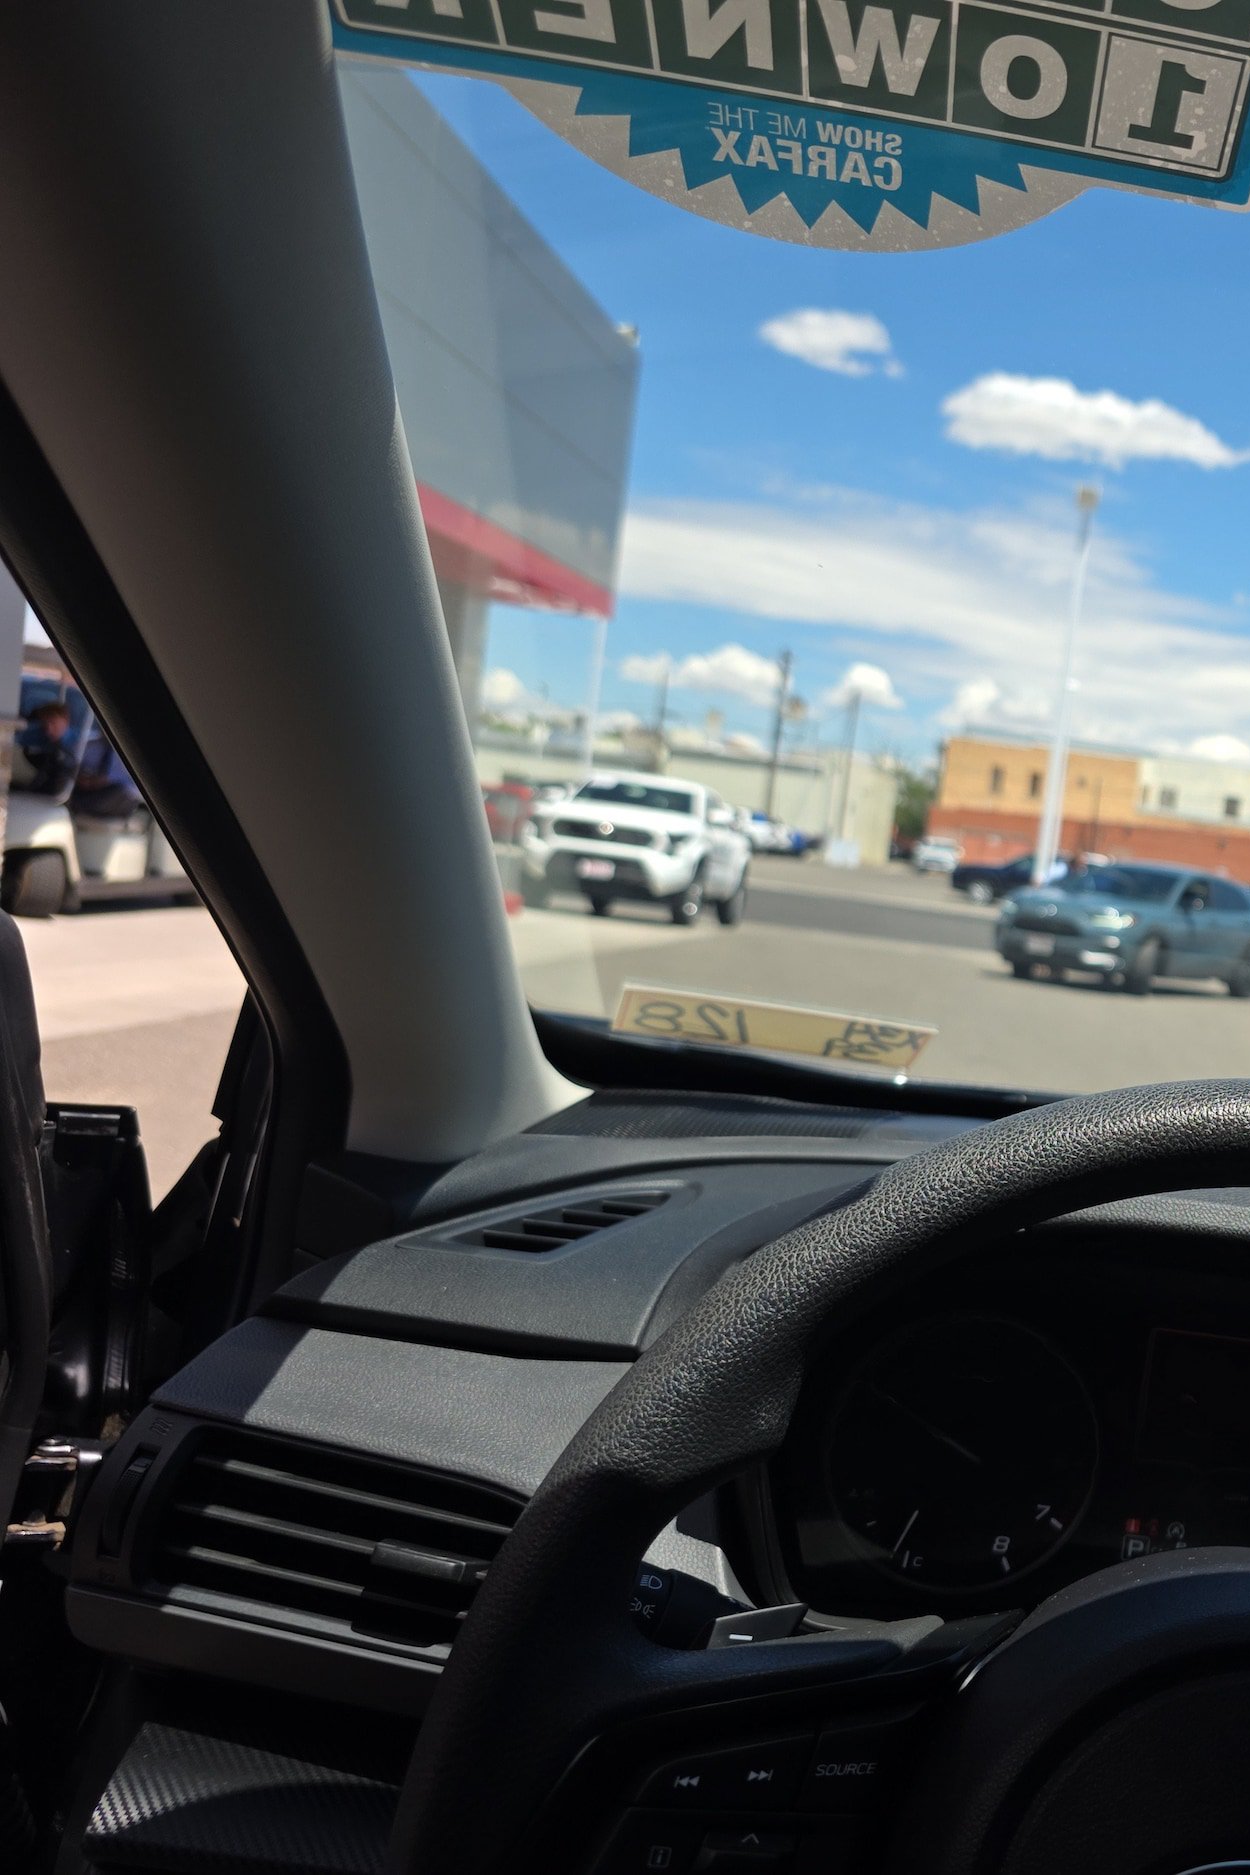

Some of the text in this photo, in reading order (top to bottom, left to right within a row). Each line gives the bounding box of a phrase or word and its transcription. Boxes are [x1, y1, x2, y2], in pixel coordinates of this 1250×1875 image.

[1035, 1503, 1051, 1520] 7
[992, 1535, 1011, 1553] 8
[815, 1762, 878, 1777] SOURCE
